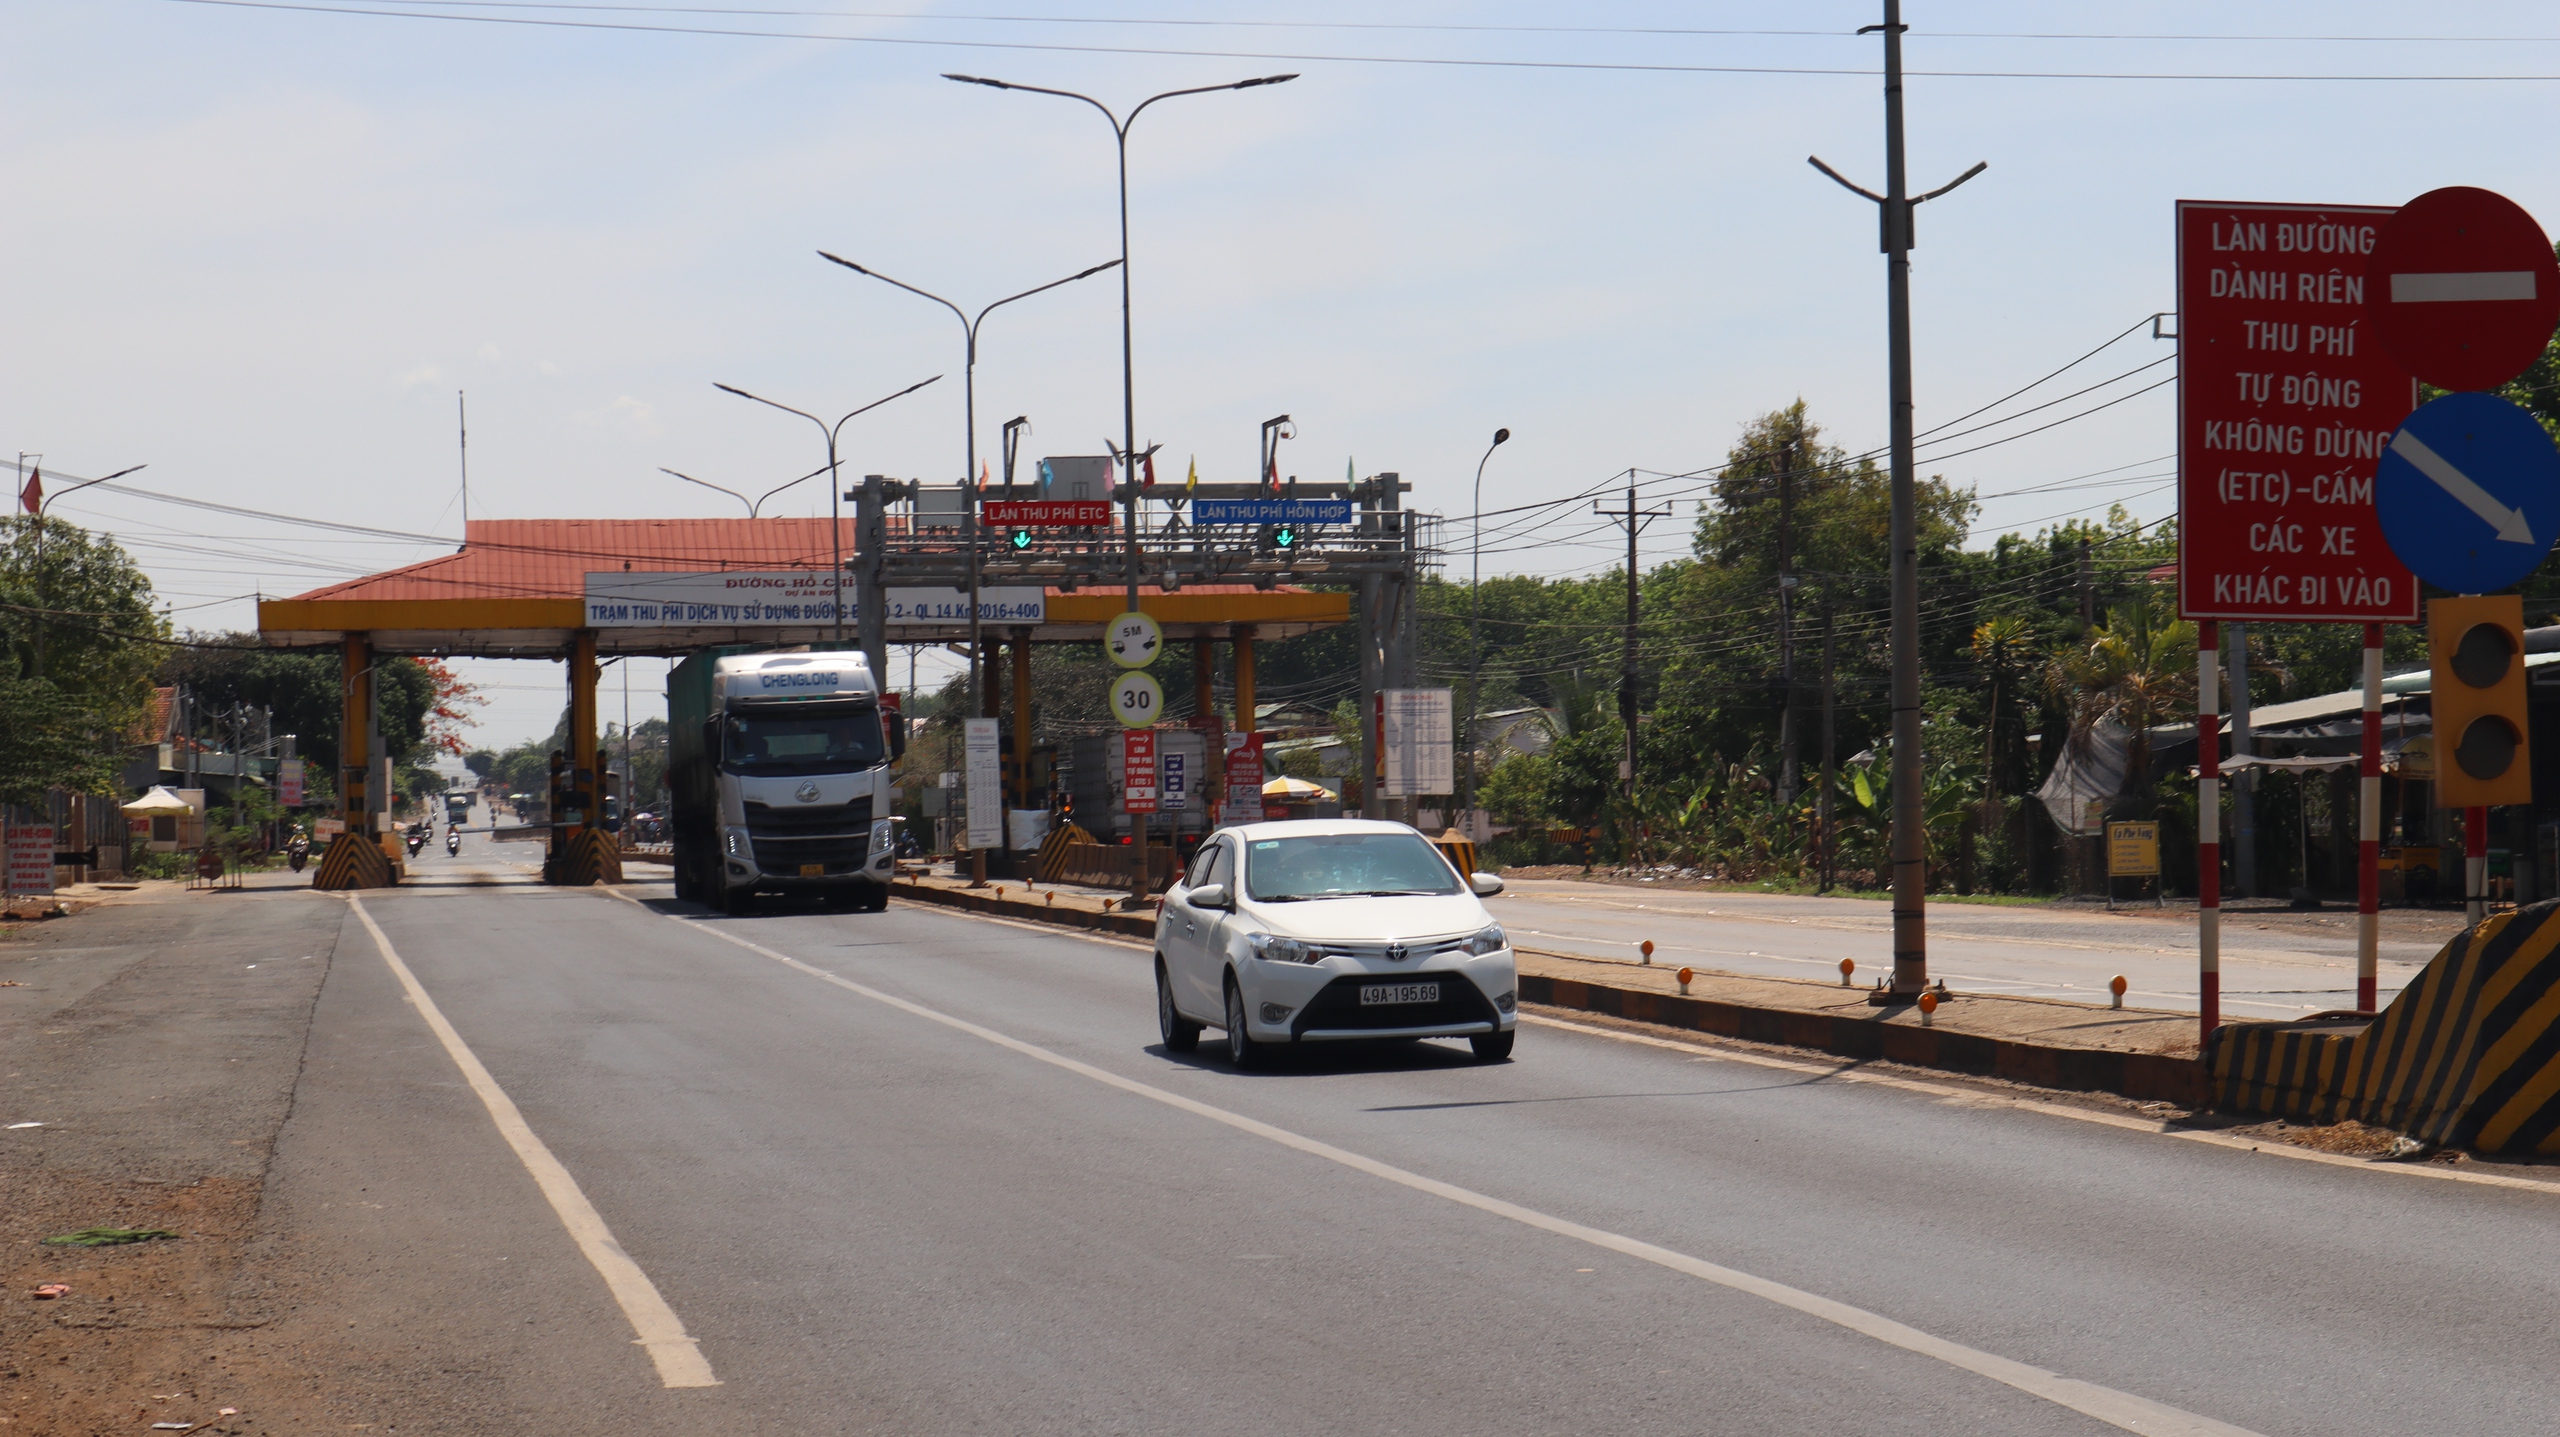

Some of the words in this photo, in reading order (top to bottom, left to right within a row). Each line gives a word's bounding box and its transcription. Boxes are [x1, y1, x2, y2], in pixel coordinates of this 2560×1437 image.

[2212, 215, 2267, 252] LÀN
[2276, 215, 2376, 255] ĐƯỜNG
[2210, 262, 2286, 300] DÀNH
[2243, 320, 2299, 353] THU
[2309, 319, 2359, 356] PHÍ
[2235, 371, 2272, 409] TỰ
[2282, 371, 2361, 412] ĐỘNG
[2204, 418, 2304, 455] KHÔNG
[2315, 420, 2391, 459] DỪNG
[989, 504, 1018, 520] LÀN
[1021, 507, 1049, 520] THU
[1052, 504, 1076, 520] PHÍ
[1079, 507, 1104, 519] ETC
[1197, 503, 1226, 519] LÀN
[1229, 506, 1256, 518] THU
[1260, 503, 1283, 518] PHÍ
[1286, 501, 1315, 518] HỖN
[1318, 506, 1347, 522] HỢP
[2249, 516, 2304, 553] CÁC
[2320, 526, 2356, 556] XE
[725, 577, 786, 589] ĐƯỜNG
[792, 574, 817, 588] HỒ
[2214, 566, 2290, 605] KHÁC
[2299, 576, 2331, 606] ĐI
[2336, 568, 2391, 607] VÀO
[591, 605, 628, 623] TRẠM
[632, 605, 658, 620] THU
[662, 602, 684, 620] PHÍ
[687, 605, 718, 623] DỊCH
[722, 605, 739, 622] VỤ
[743, 600, 761, 620] SỬ
[765, 605, 800, 622] DỤNG
[895, 604, 903, 618] 2
[915, 604, 931, 620] QL
[936, 604, 952, 618] 14
[1122, 625, 1142, 637] 5M
[762, 672, 839, 688] CHENGLONG
[1123, 689, 1151, 709] 30
